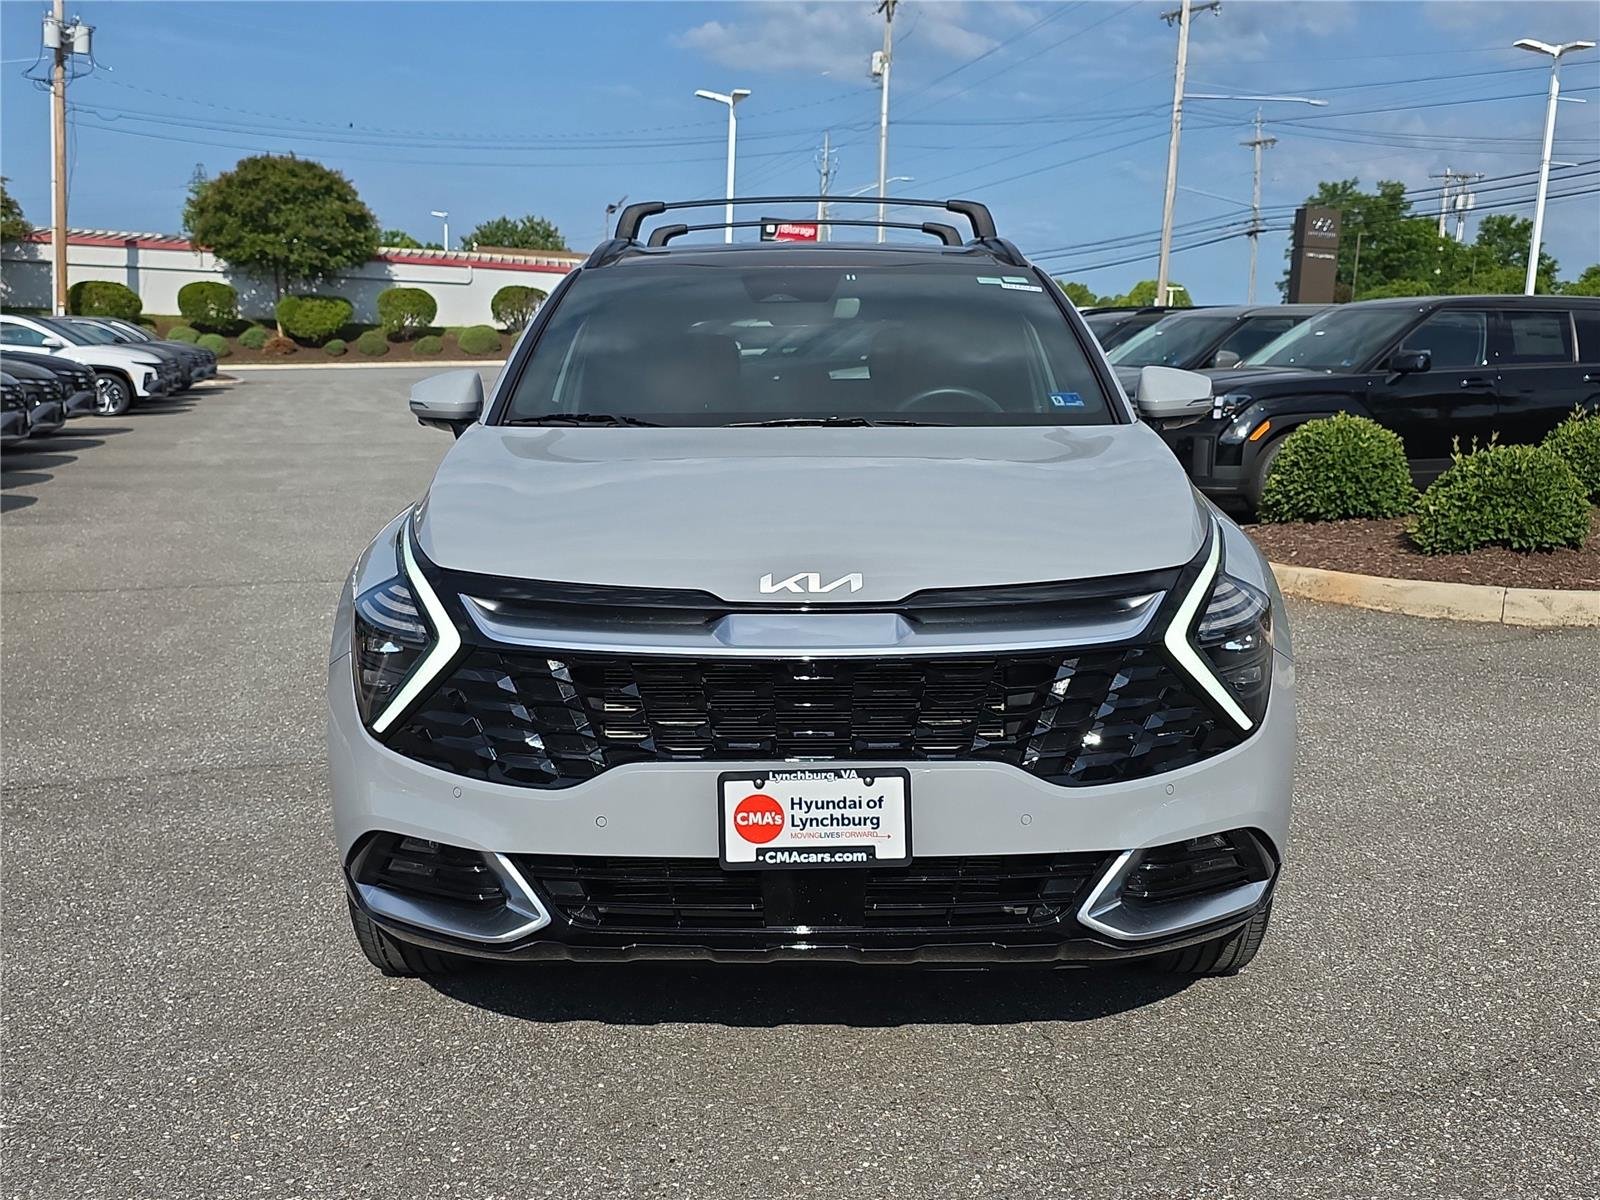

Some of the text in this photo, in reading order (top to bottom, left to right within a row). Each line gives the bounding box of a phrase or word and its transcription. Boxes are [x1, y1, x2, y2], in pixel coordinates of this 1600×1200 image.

[768, 769, 858, 783] Lynchburg, VA
[790, 795, 884, 814] Hyundai of
[736, 812, 782, 826] CMA's
[790, 814, 880, 830] Lynchburg
